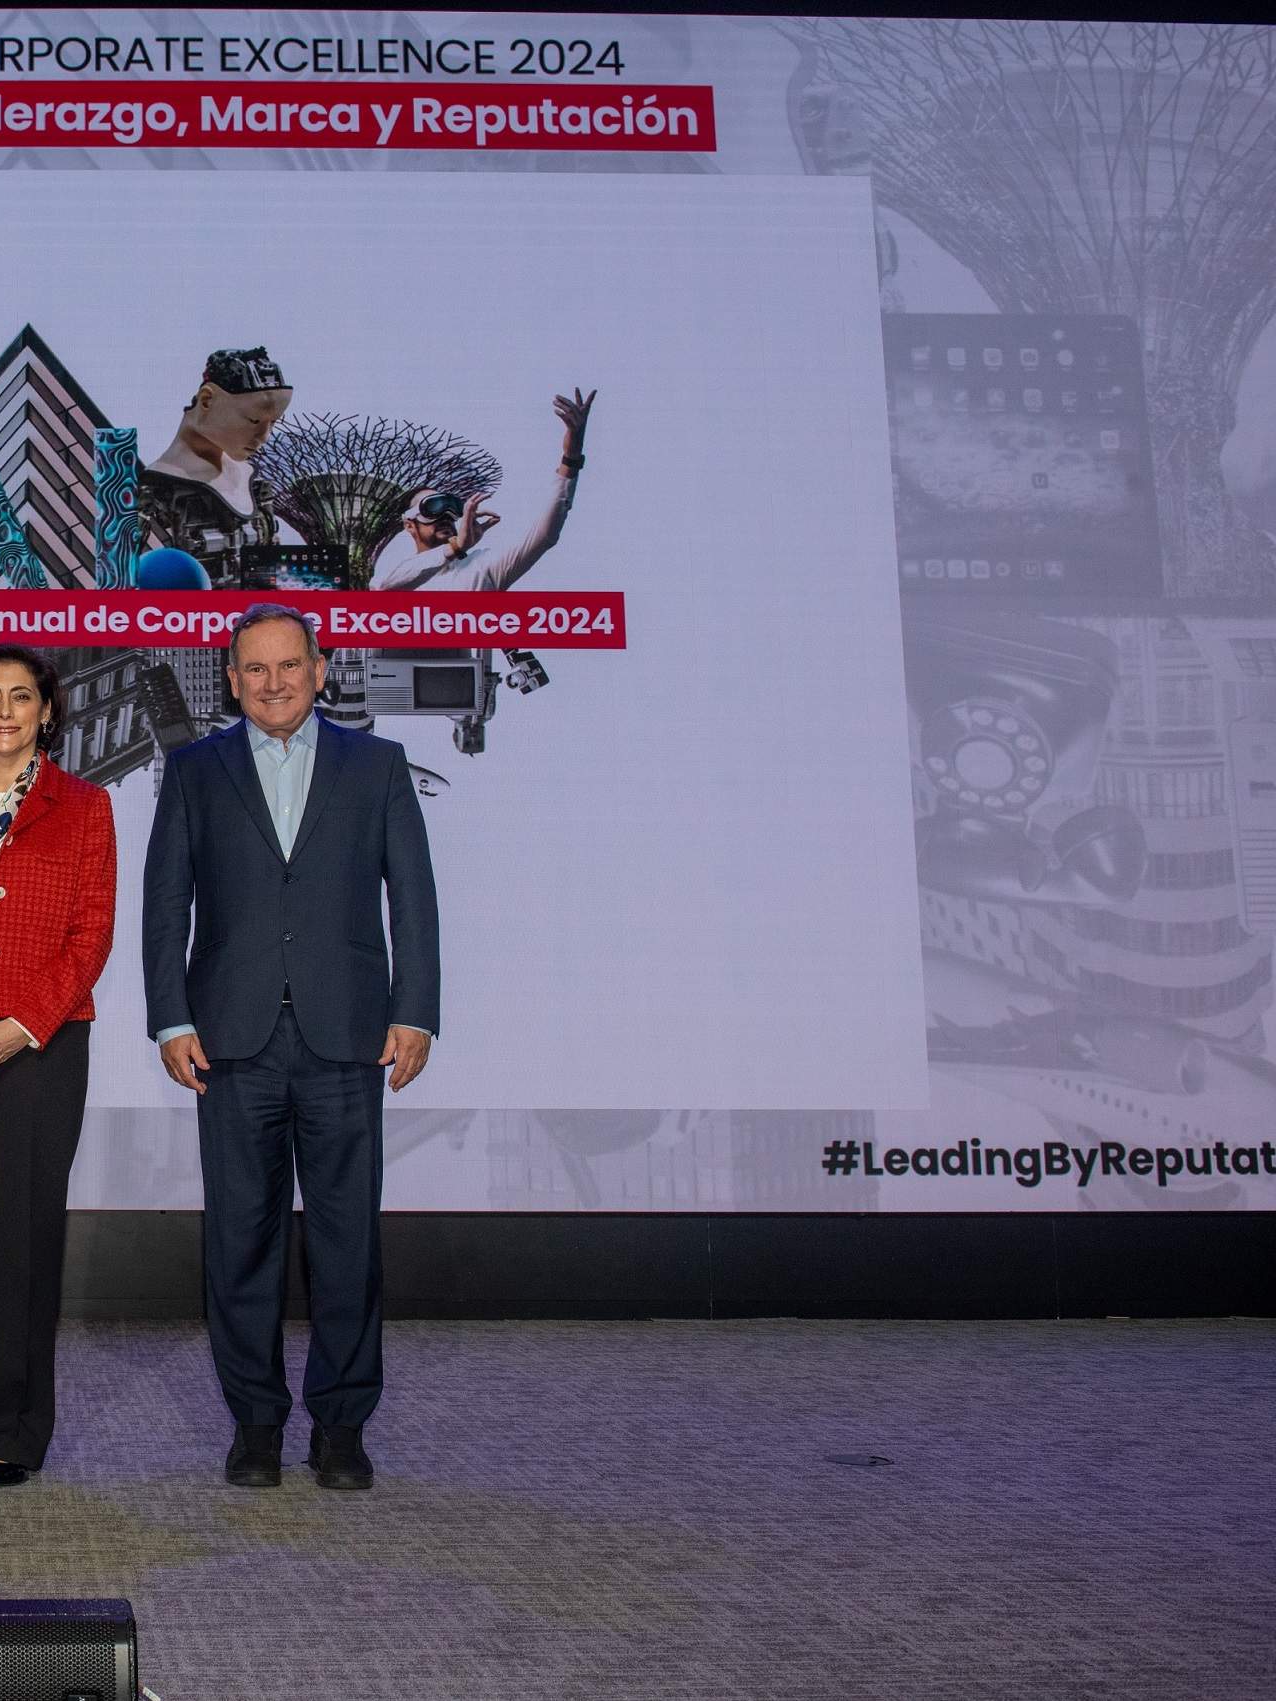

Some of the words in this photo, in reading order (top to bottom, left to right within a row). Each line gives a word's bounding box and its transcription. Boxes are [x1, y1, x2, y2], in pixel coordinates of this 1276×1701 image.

[220, 38, 496, 74] EXCELLENCE
[510, 39, 625, 74] 2024
[201, 96, 359, 133] Marca
[371, 104, 402, 145] y
[413, 94, 698, 146] Reputación
[84, 604, 130, 633] de
[136, 606, 323, 643] Corpoe
[330, 606, 521, 635] Excellence
[527, 606, 615, 635] 2024
